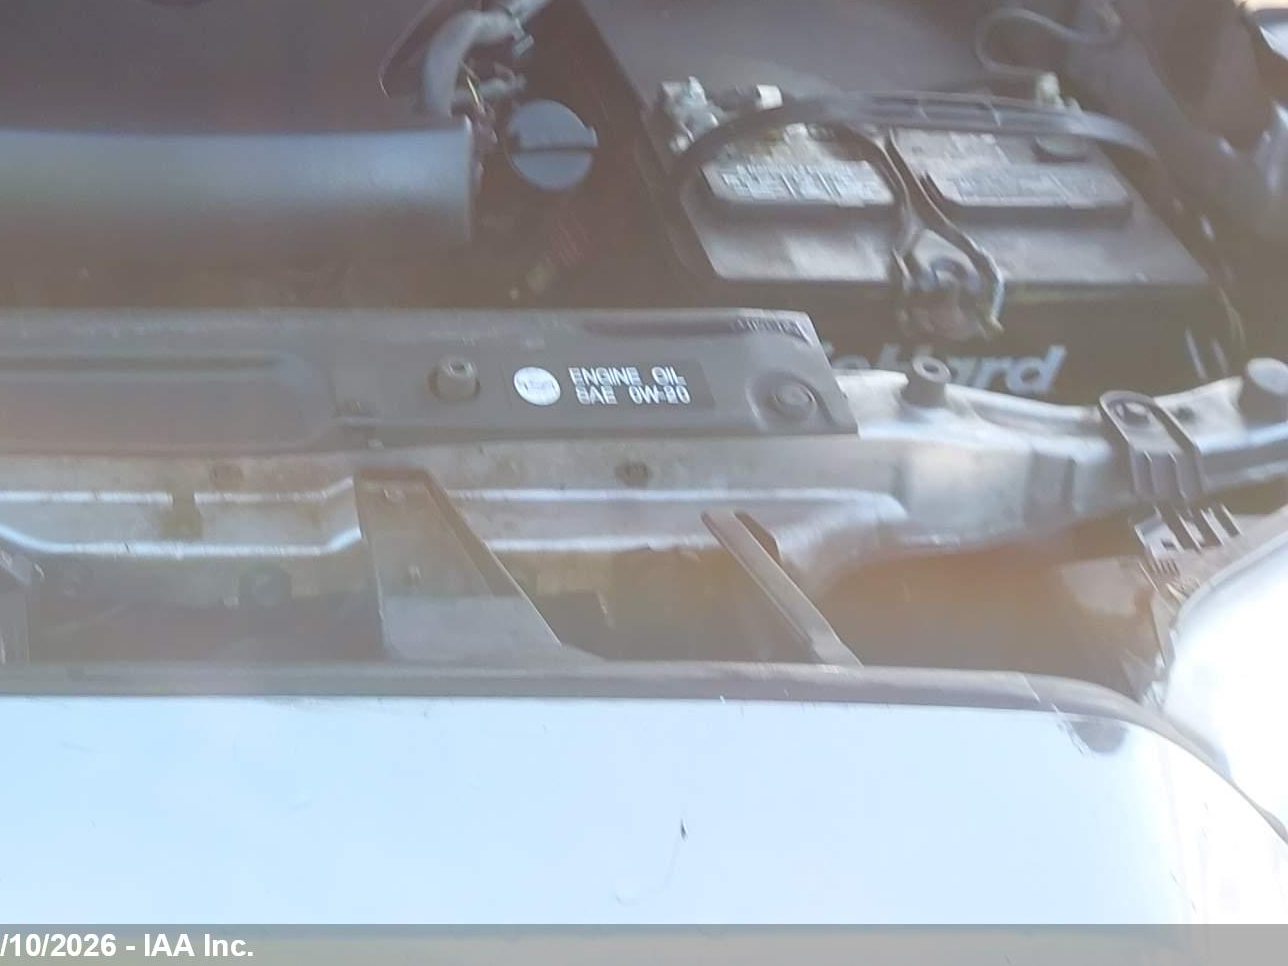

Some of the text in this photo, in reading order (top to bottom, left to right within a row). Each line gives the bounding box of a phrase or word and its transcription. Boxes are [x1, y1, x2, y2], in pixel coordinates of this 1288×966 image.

[568, 366, 688, 386] ENGINE OIL
[575, 385, 618, 405] SAE
